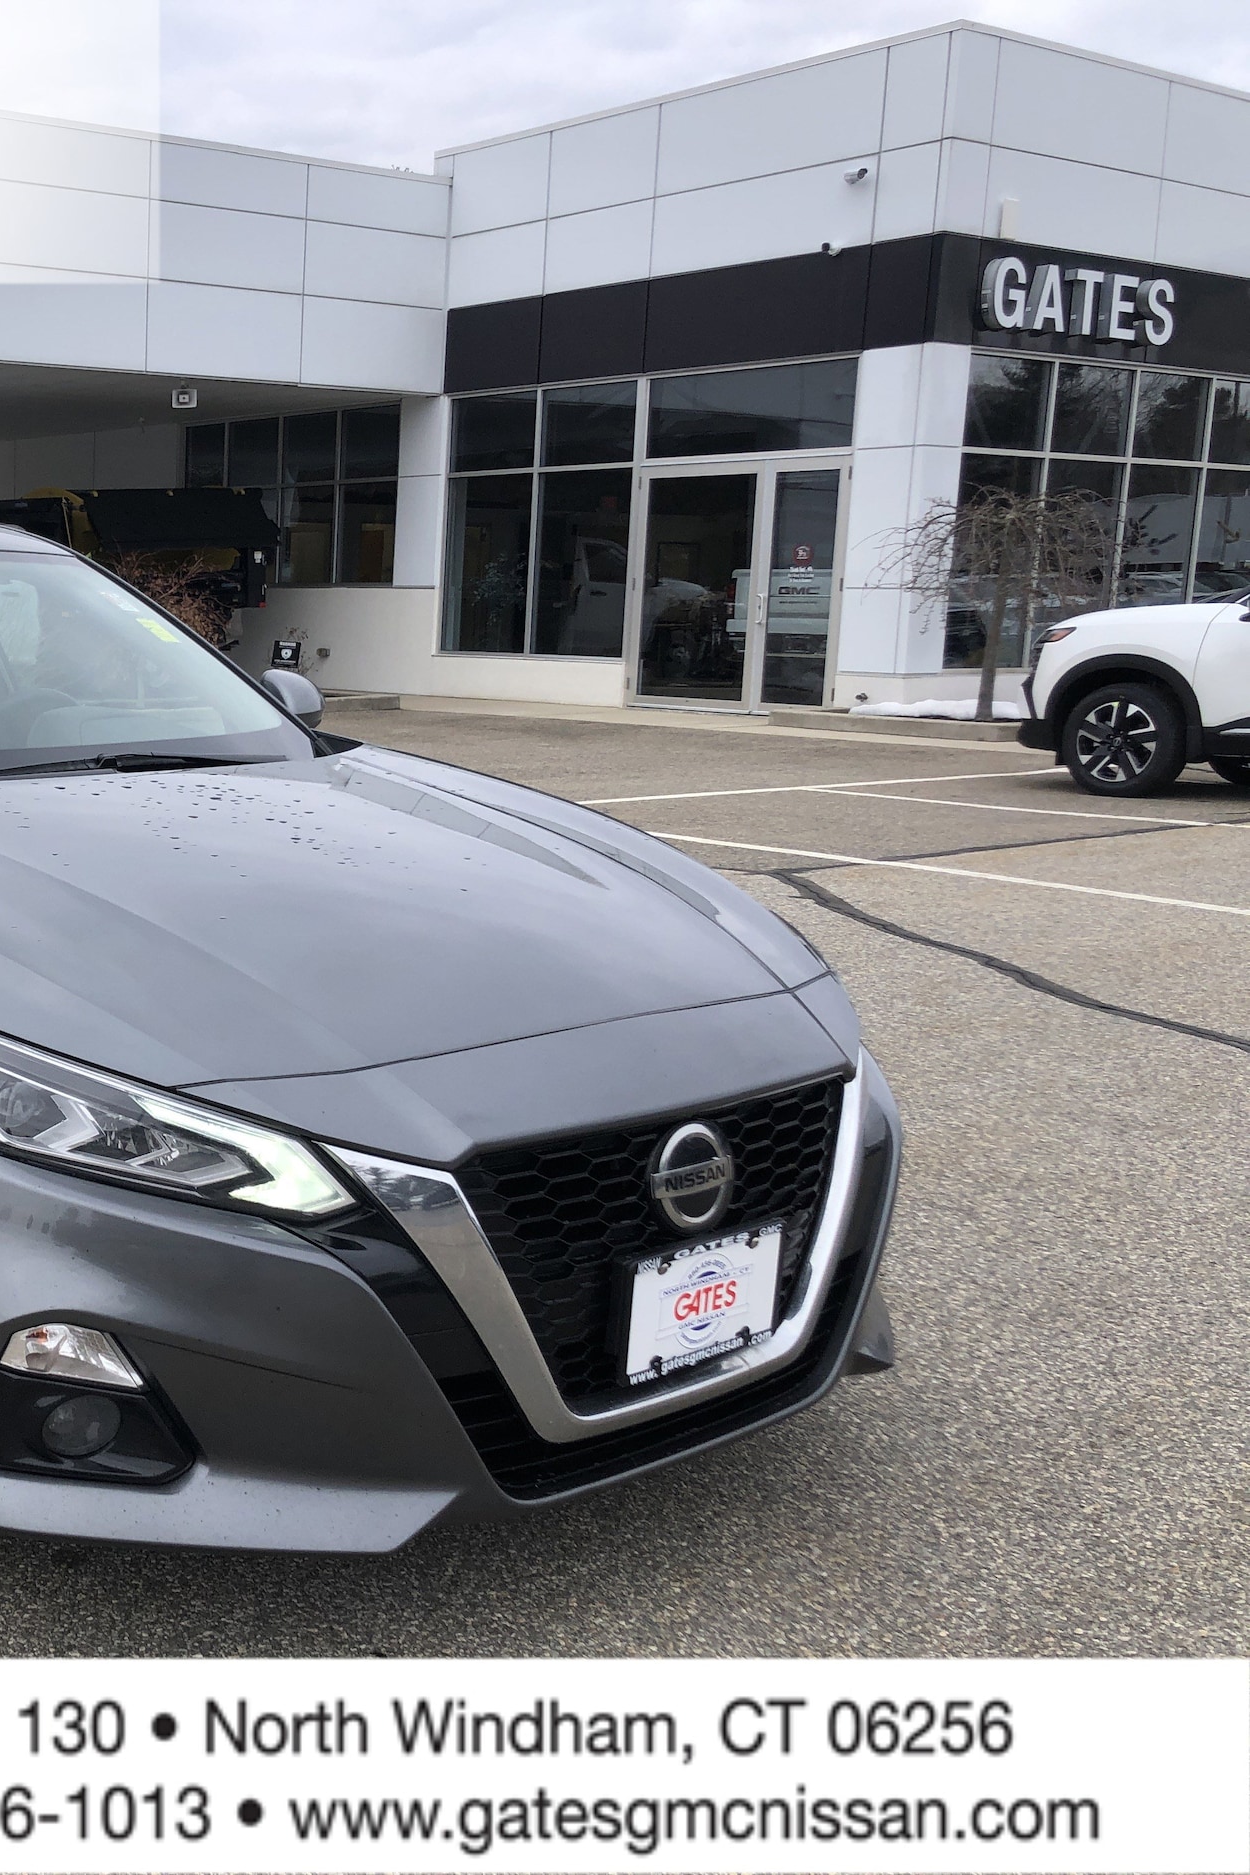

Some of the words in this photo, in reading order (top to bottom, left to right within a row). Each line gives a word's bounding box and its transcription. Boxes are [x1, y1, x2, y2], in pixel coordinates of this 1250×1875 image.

[982, 256, 1176, 346] GATES
[778, 586, 821, 595] GMC
[664, 1163, 726, 1193] NISSAN
[673, 1232, 751, 1260] GATES
[758, 1223, 784, 1237] GMC
[673, 1279, 737, 1321] GATES
[696, 1311, 726, 1324] NISSAN
[629, 1367, 659, 1386] www.
